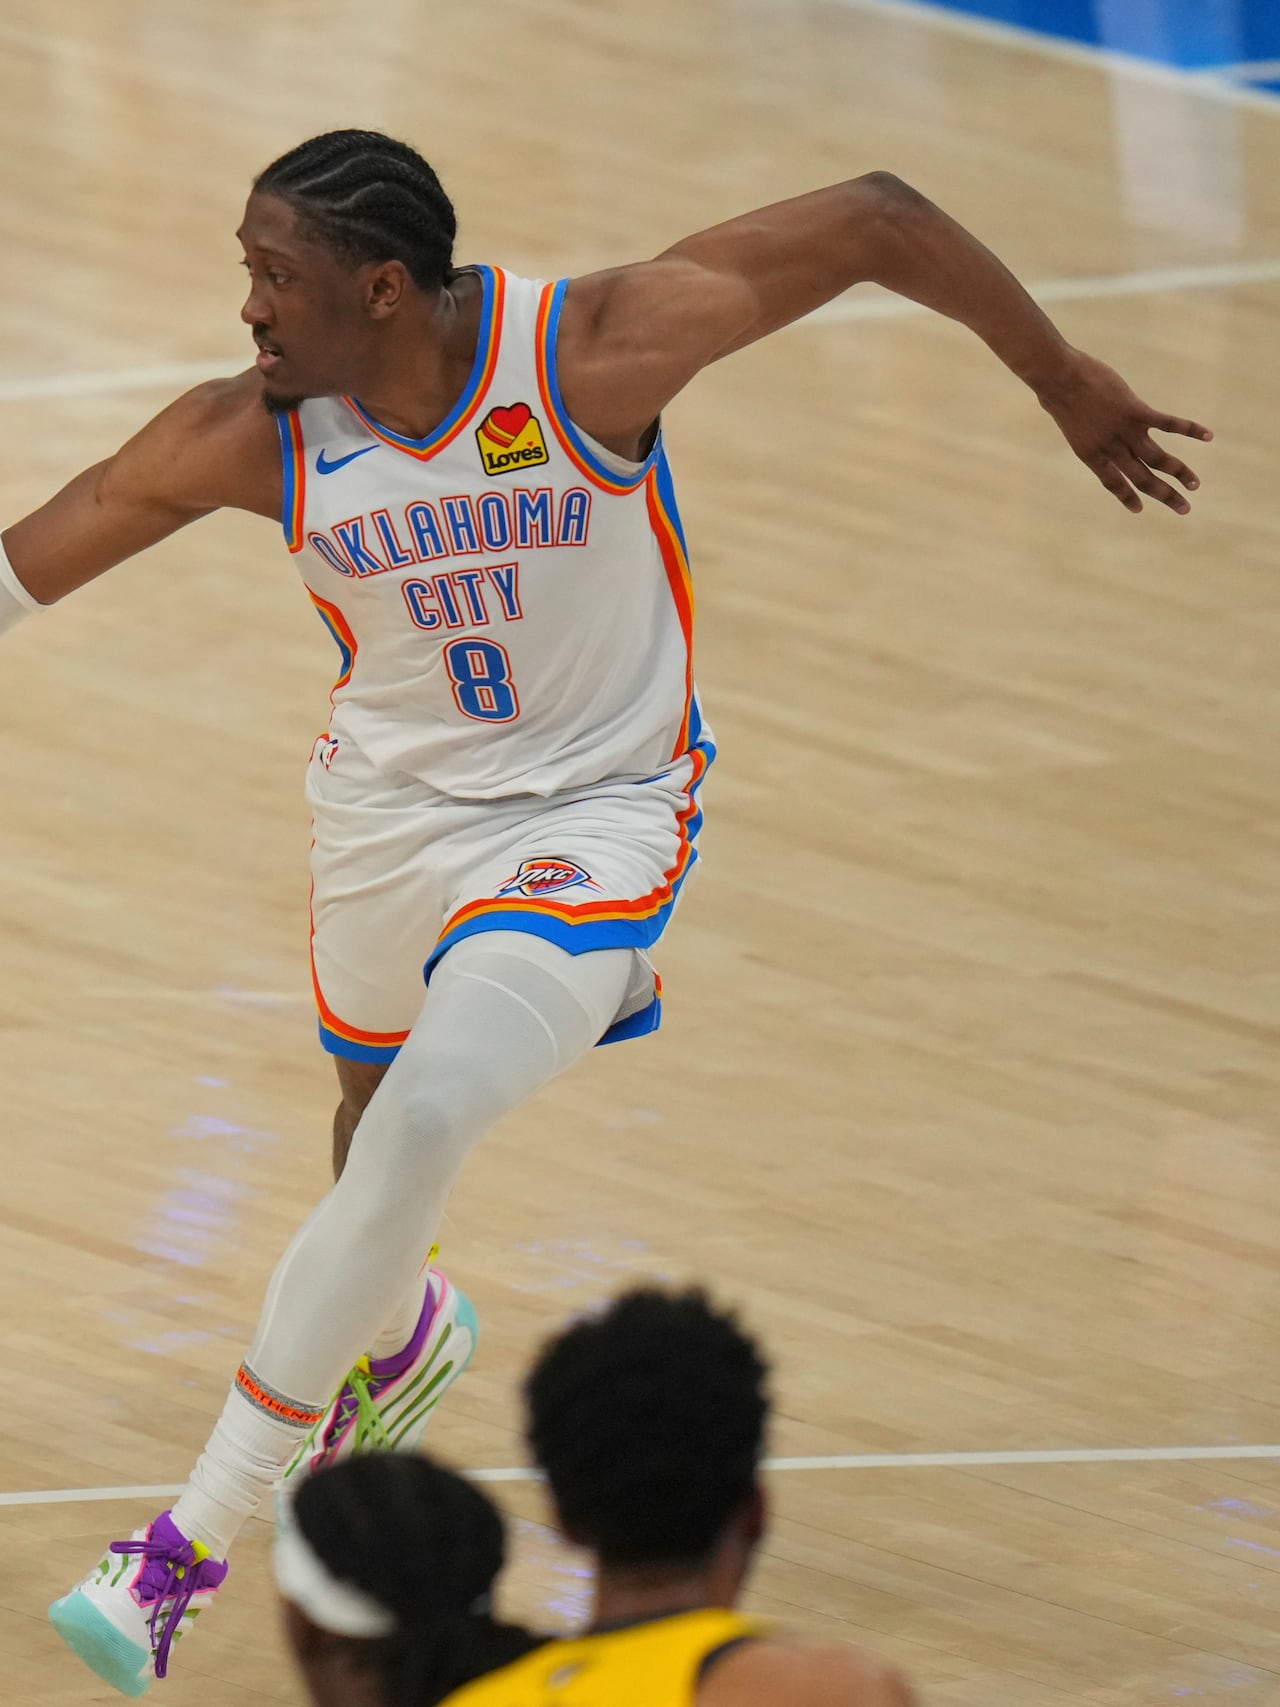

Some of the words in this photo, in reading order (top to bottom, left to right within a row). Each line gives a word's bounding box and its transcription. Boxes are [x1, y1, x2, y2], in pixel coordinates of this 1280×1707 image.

[308, 487, 591, 578] OKLAHOMA
[401, 562, 523, 630] CITY
[443, 637, 520, 723] 8
